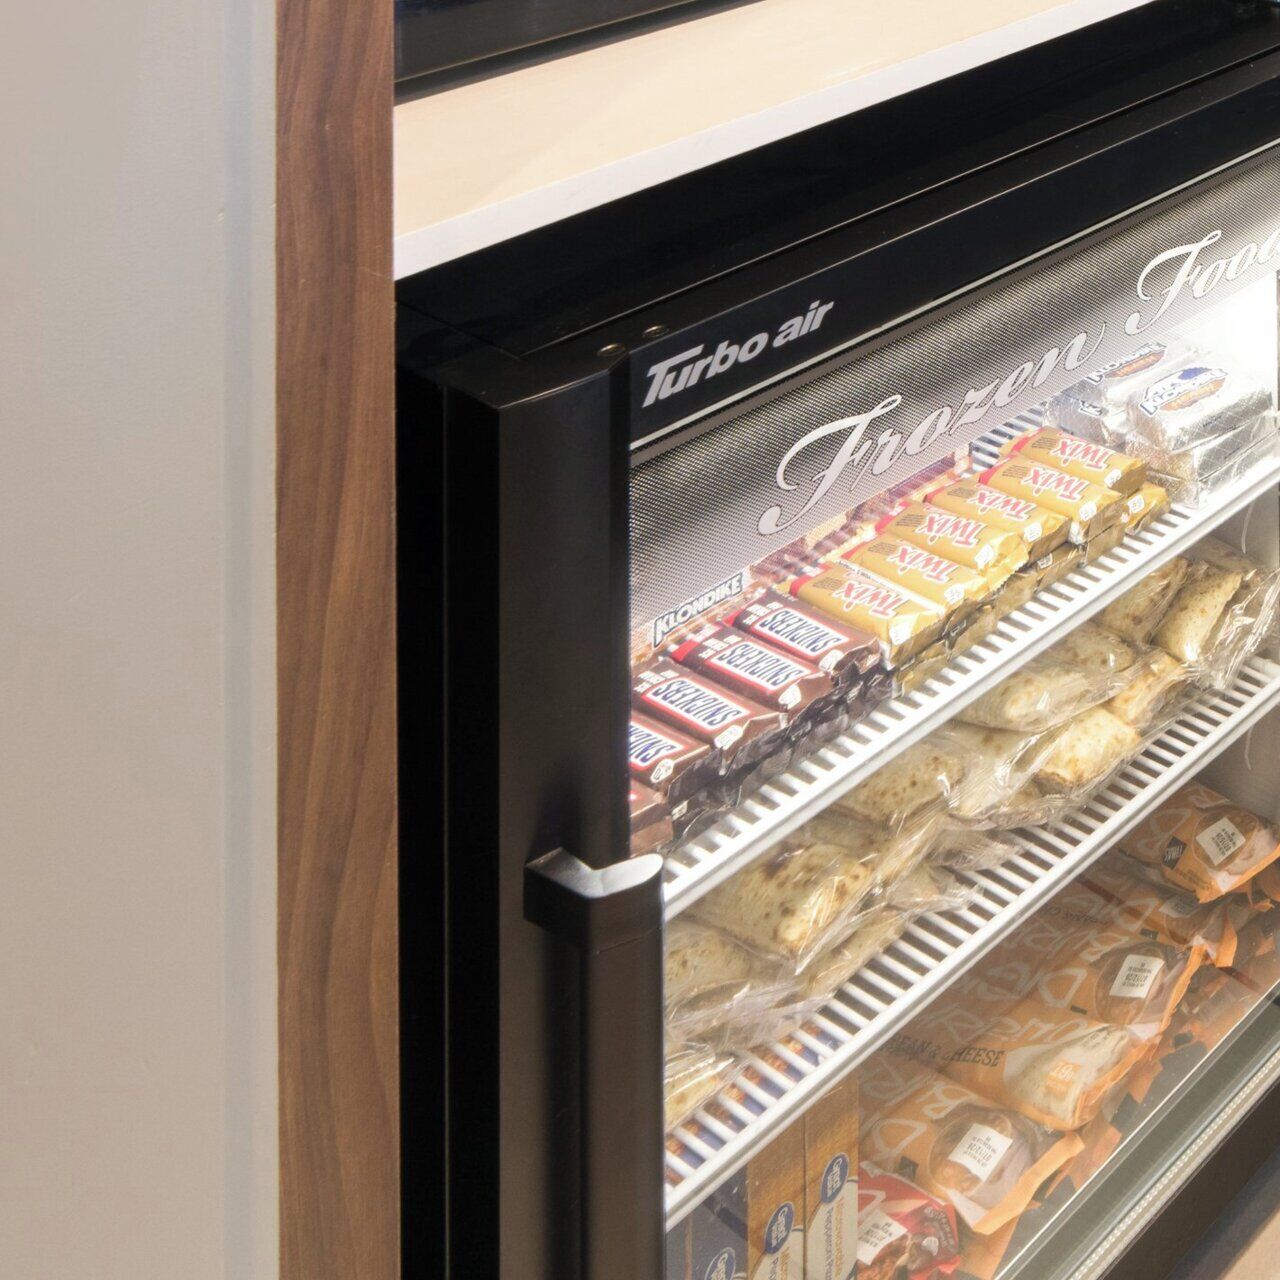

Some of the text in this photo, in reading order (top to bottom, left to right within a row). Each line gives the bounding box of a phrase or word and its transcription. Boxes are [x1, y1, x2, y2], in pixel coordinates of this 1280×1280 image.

[641, 300, 836, 410] Turbo air
[757, 320, 1107, 538] Frozen
[653, 572, 743, 649] KLONDIKE
[758, 607, 841, 653] SNICKERS
[718, 642, 801, 688] SNICKERS
[653, 679, 744, 728] SNICKERS
